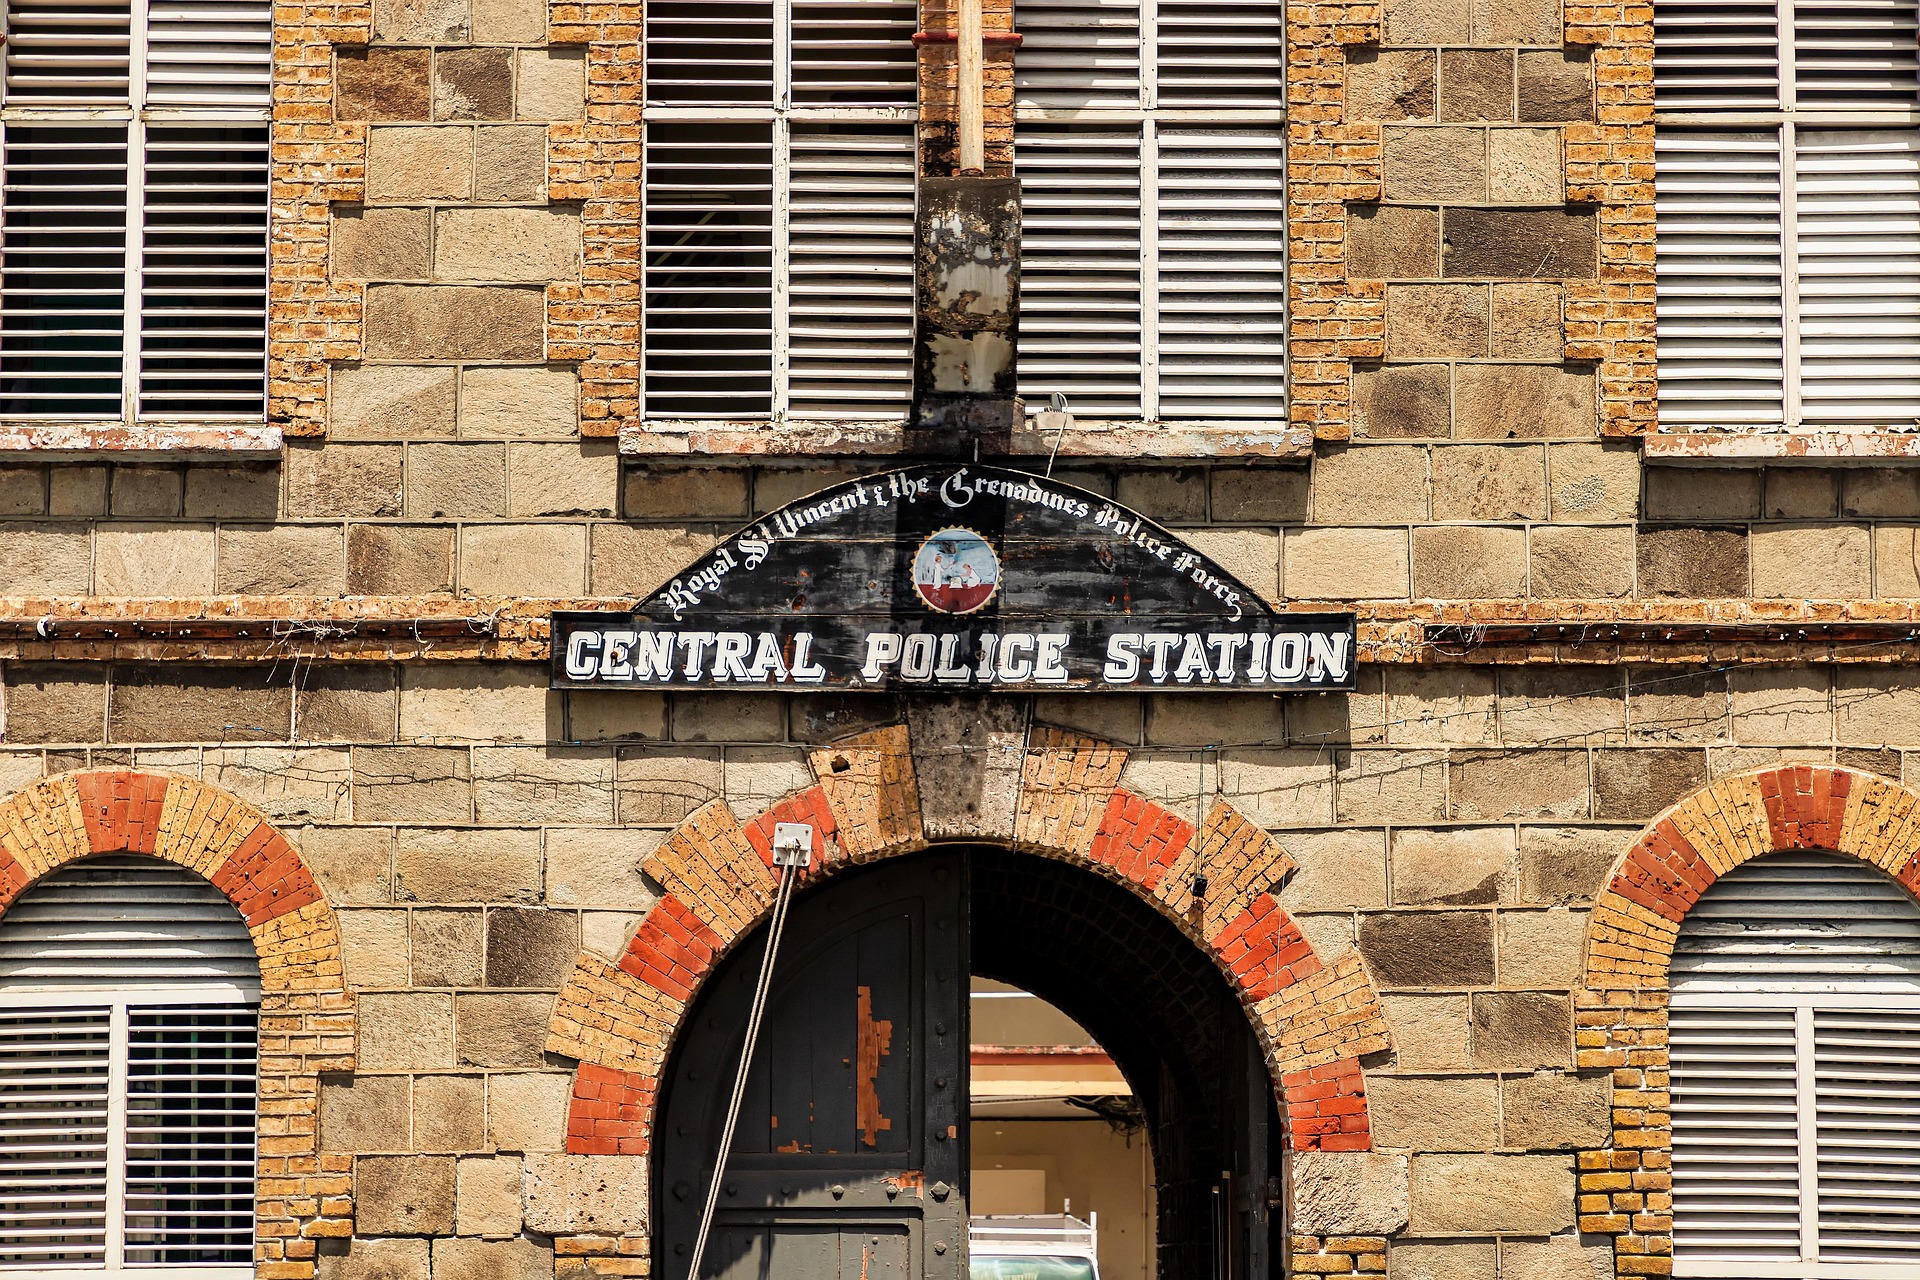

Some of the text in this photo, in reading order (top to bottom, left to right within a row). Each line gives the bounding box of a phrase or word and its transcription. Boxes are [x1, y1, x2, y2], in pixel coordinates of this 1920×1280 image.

[660, 548, 738, 621] Royal
[773, 482, 869, 538] Vincent
[887, 472, 930, 503] the
[940, 467, 1088, 518] Grenadines
[1094, 503, 1172, 560] Police
[1172, 552, 1243, 622] Force
[565, 630, 1353, 684] CENTRAL POLICE STATION
